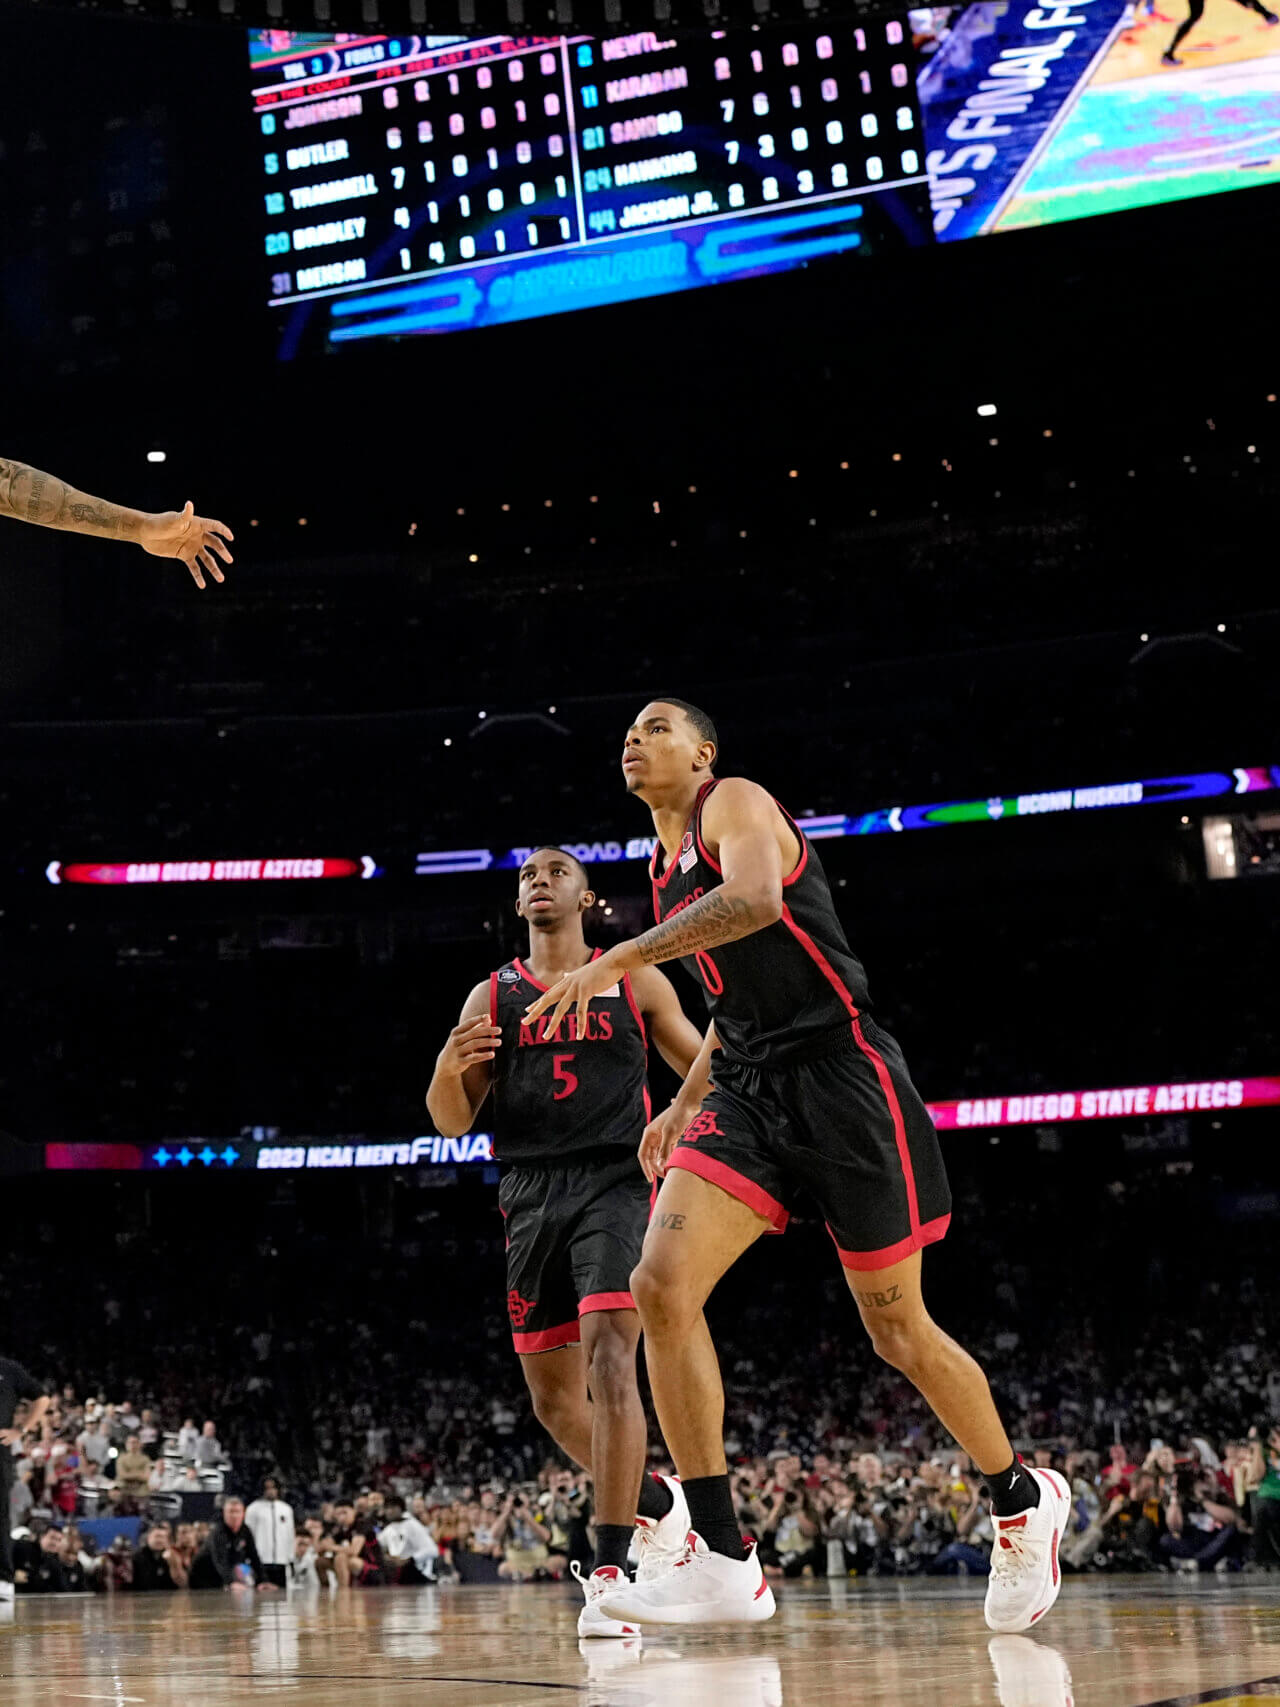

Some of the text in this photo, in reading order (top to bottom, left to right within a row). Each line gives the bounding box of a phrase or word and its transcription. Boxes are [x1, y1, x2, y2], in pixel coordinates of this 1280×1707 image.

[447, 73, 459, 95] 1
[581, 84, 599, 109] 11
[750, 50, 763, 73] 1
[854, 28, 866, 51] 1
[947, 30, 1077, 141] FINAL
[719, 99, 735, 123] 7
[790, 86, 802, 108] 1
[860, 71, 871, 93] 1
[286, 138, 350, 171] BUTLER
[515, 100, 527, 122] 1
[390, 166, 406, 190] 7
[423, 160, 436, 183] 1
[486, 147, 499, 170] 1
[584, 166, 612, 193] 24
[614, 150, 698, 187] HAWKINS
[724, 140, 740, 165] 7
[292, 216, 367, 251] BRADLEY
[427, 200, 439, 224] 1
[458, 194, 471, 218] 1
[554, 175, 567, 199] 1
[619, 194, 691, 229] JACKSON
[296, 257, 367, 291] MENSAH
[399, 247, 411, 271] 1
[494, 229, 506, 253] 1
[526, 223, 538, 246] 1
[558, 216, 571, 240] 1
[126, 858, 325, 883] SAN DIEGO STATE AZTECS
[552, 1053, 579, 1100] 5
[955, 1081, 1245, 1126] SAN DIEGO STATE AZTECS
[257, 1146, 306, 1169] 2023
[306, 1145, 354, 1168] NCAA
[410, 1133, 494, 1165] FINA
